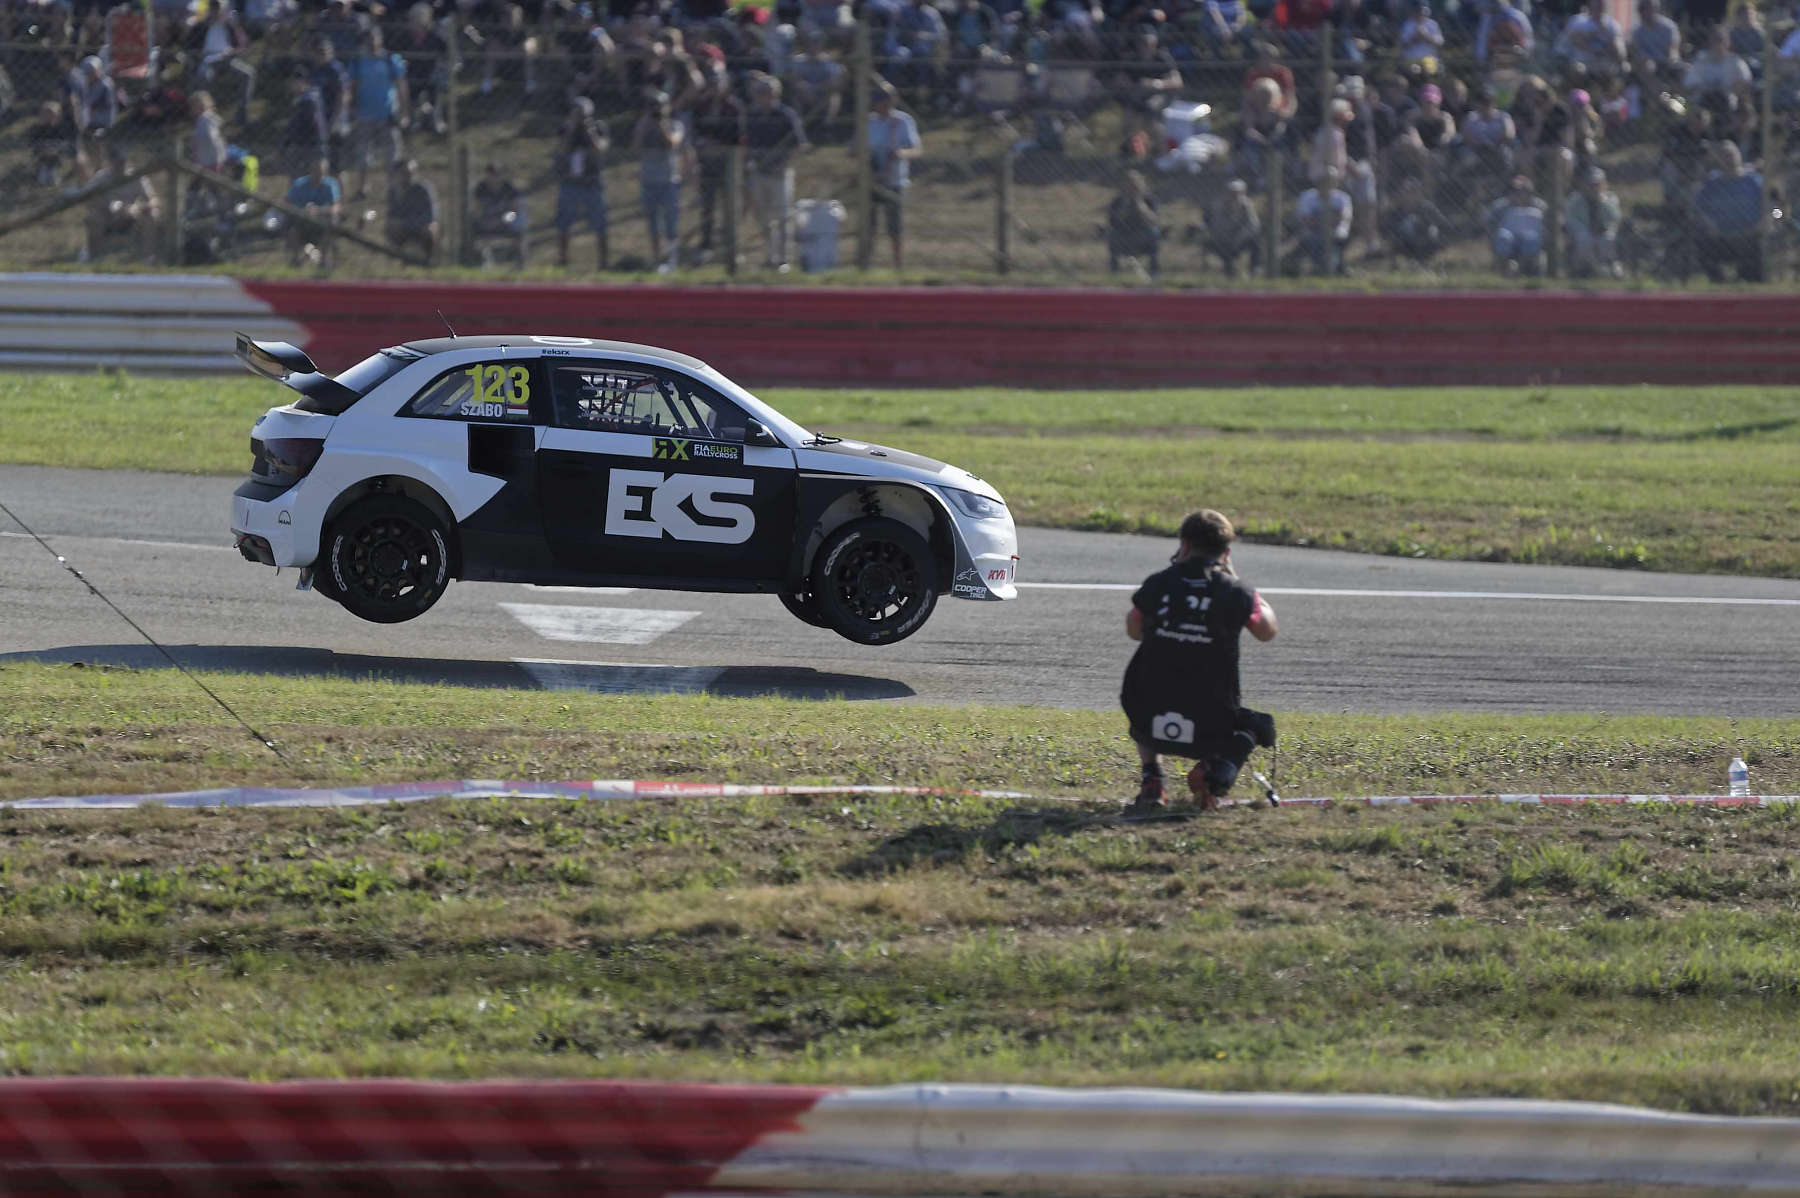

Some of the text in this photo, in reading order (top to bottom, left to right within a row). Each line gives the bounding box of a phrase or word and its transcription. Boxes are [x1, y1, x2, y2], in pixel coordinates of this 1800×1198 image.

[465, 364, 530, 405] 123
[460, 403, 503, 418] SZABO
[693, 452, 738, 460] RALLYCROSS
[605, 468, 756, 544] EKS
[954, 584, 987, 594] COOPER
